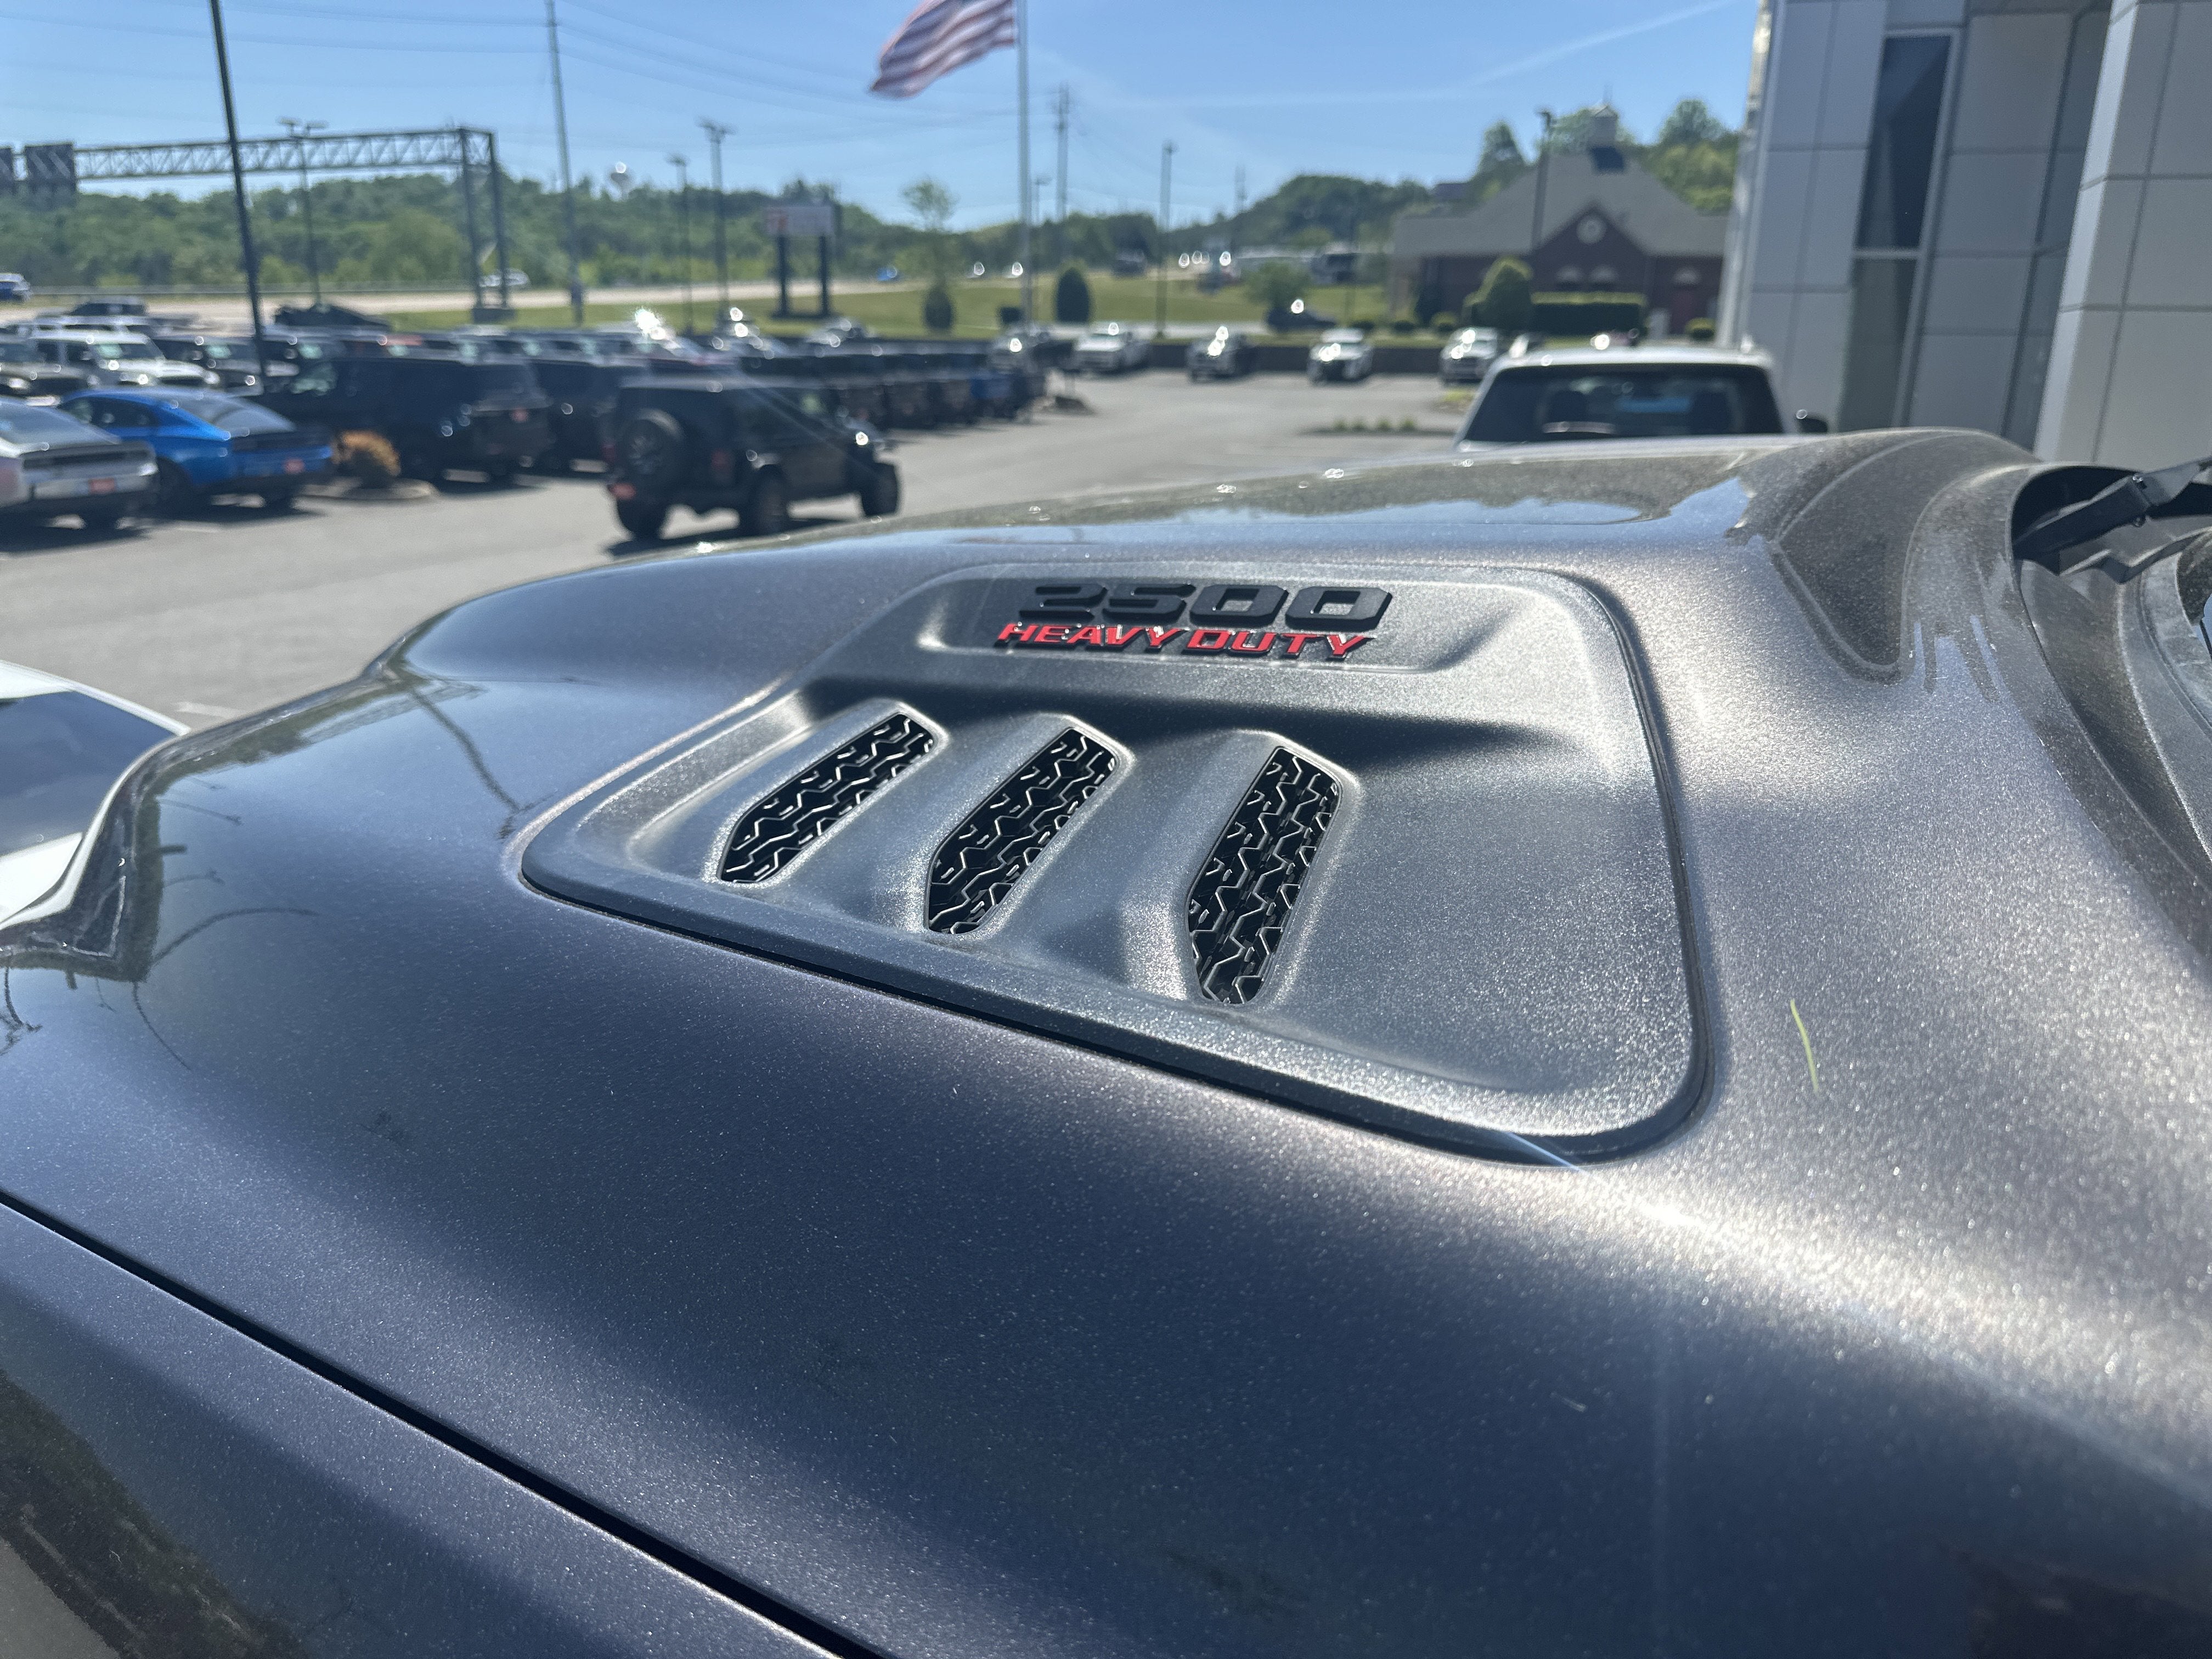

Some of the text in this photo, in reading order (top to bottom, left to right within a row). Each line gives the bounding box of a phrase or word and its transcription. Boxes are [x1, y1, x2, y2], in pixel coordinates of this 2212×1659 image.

[1018, 583, 1393, 633] 2500
[996, 623, 1375, 658] HEAVY DUTY
